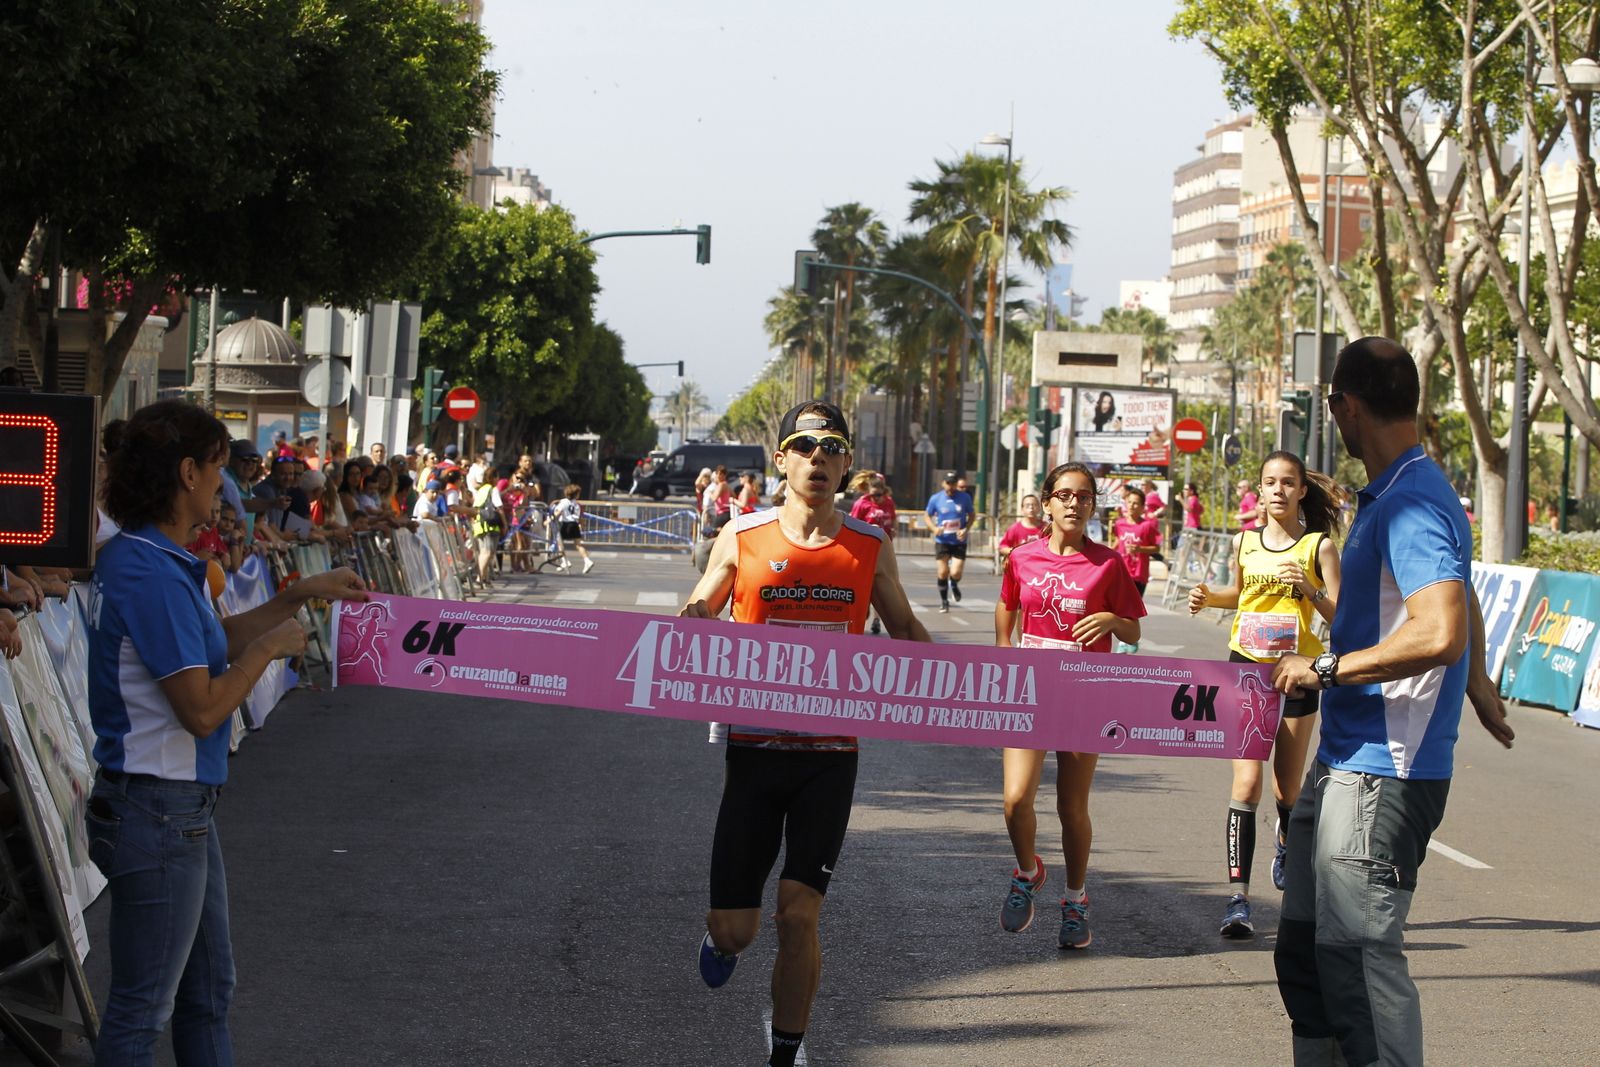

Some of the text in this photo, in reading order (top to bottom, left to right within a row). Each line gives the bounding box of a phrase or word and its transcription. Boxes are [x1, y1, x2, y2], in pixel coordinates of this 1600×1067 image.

[1123, 400, 1169, 413] TODO TIENE
[761, 588, 853, 601] GADOR CORRE
[439, 608, 599, 630] lasallecorreparaayudar.com
[402, 620, 467, 657] 6K
[615, 620, 1038, 710] 4 CARRERA SOLIDARIA
[1059, 660, 1193, 679] lasallecorreparaayudar.com
[658, 679, 1035, 733] POR LAS ENFERMEDADES POCO FRECUENTES
[1170, 684, 1220, 722] 6K
